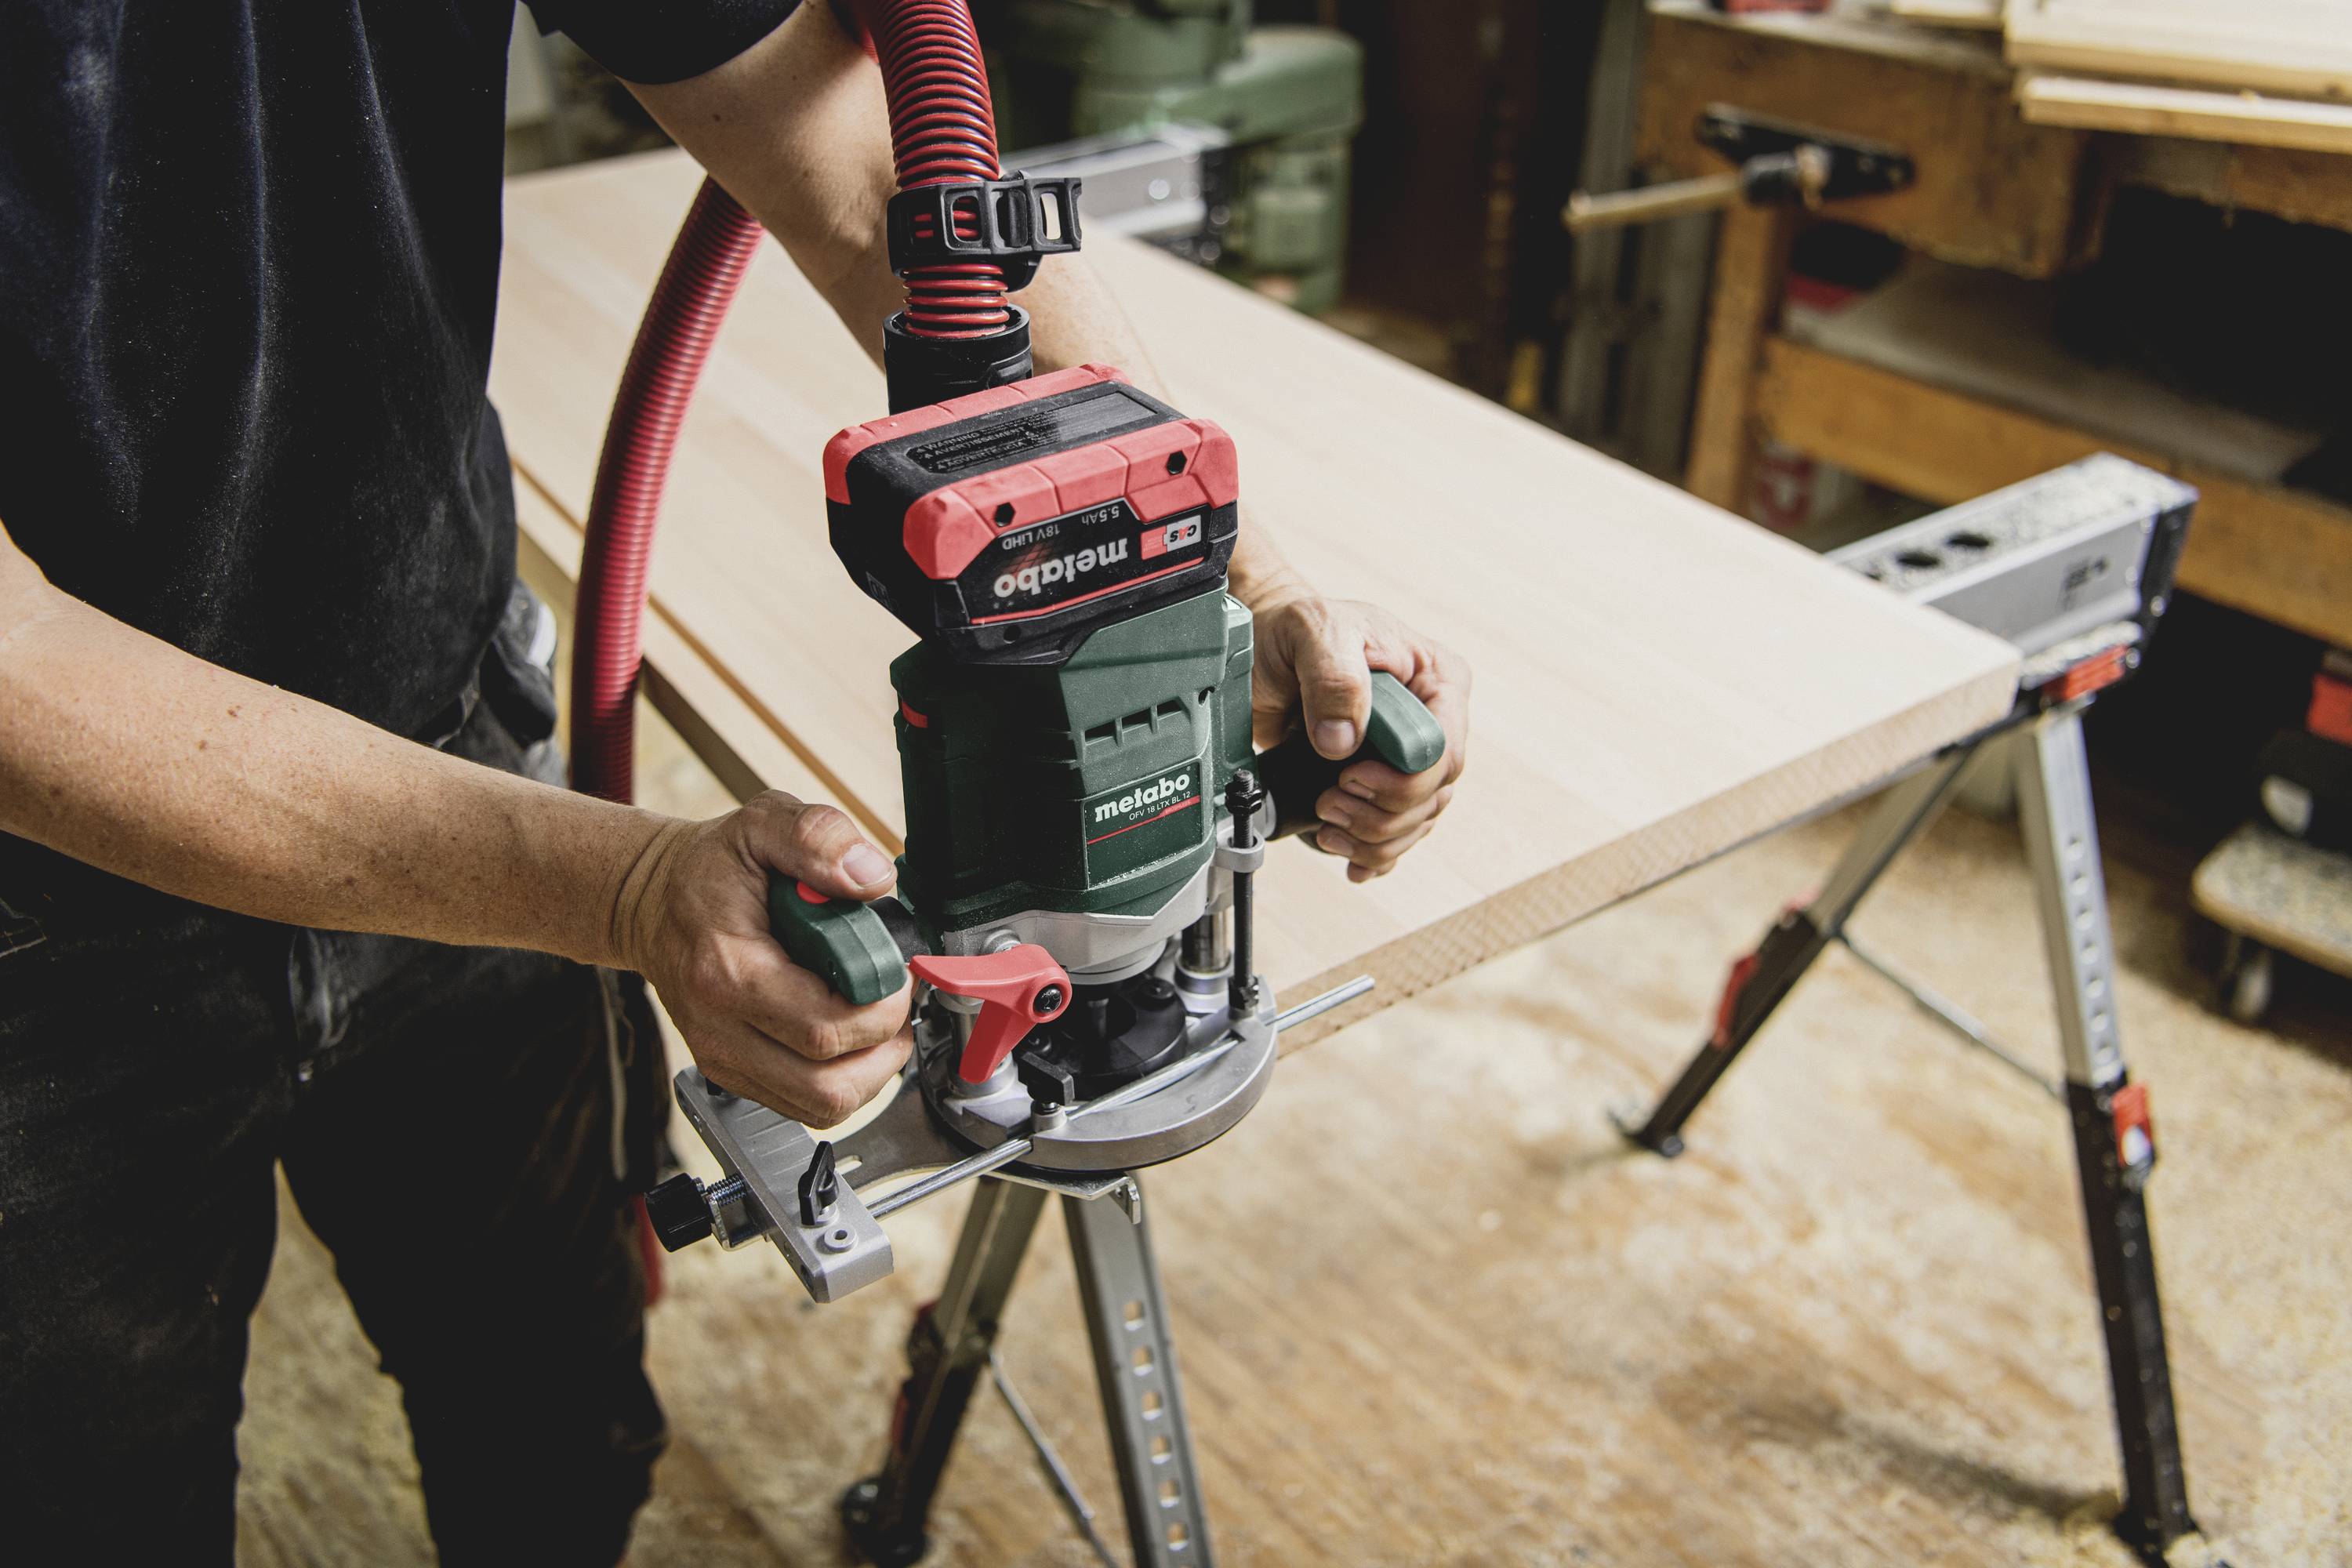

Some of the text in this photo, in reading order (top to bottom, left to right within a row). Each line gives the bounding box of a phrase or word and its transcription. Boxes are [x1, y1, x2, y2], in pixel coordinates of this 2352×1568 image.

[1002, 505, 1120, 550] 5.5Ah 18V LiHD
[1169, 524, 1197, 543] CAS
[993, 537, 1127, 598] metabo
[1094, 774, 1190, 822] metabo
[1129, 809, 1145, 821] OFV
[1156, 799, 1170, 811] LTX
[1171, 795, 1181, 804] BL
[1182, 791, 1191, 800] 12
